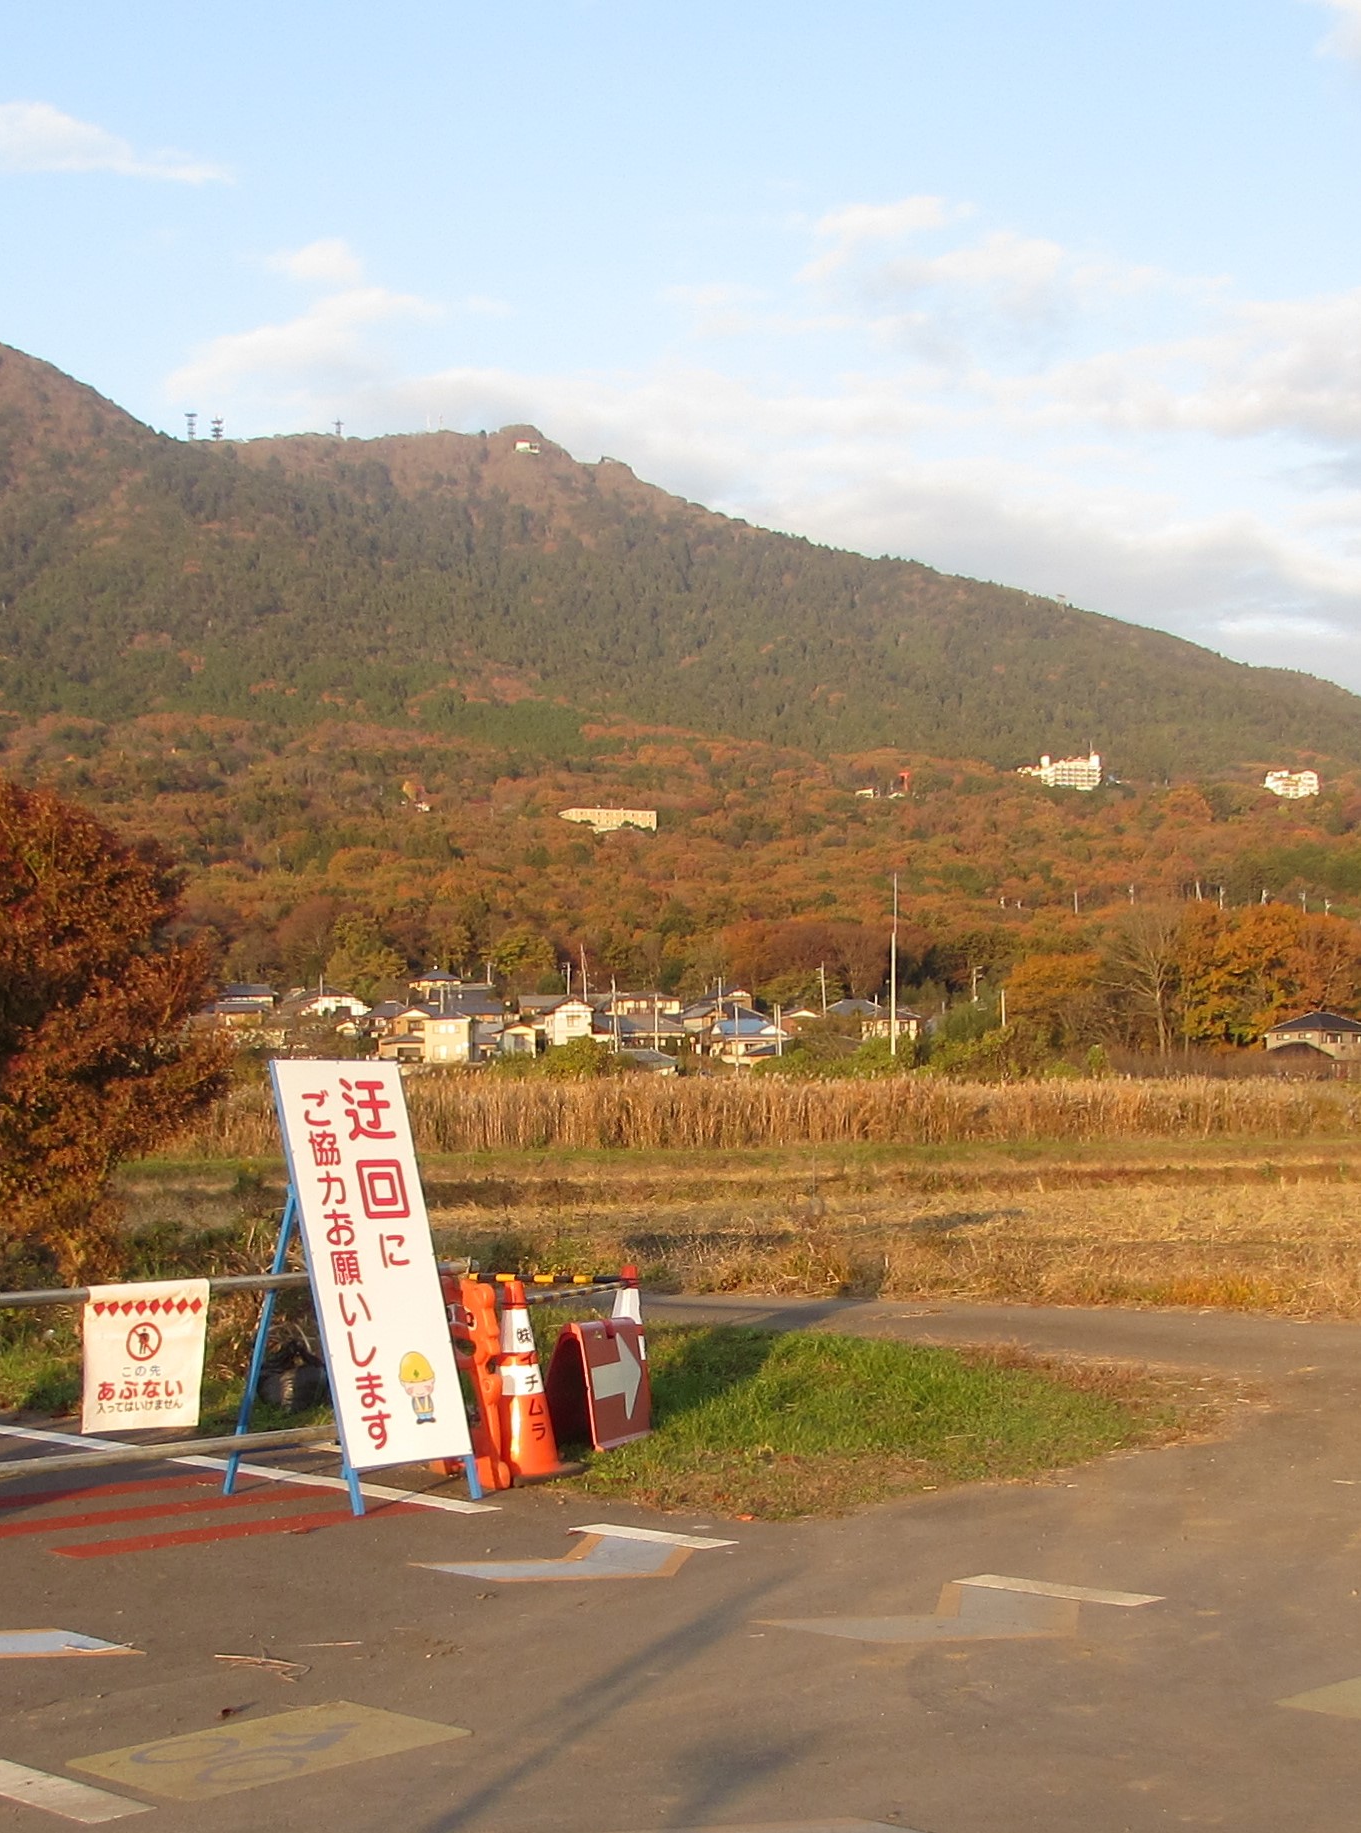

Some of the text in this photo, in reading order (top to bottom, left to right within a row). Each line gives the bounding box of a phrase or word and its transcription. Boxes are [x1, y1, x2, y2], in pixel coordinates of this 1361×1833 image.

[338, 1078, 411, 1268] 迂回に
[301, 1089, 392, 1450] ご協力お願いします
[122, 1365, 162, 1378] この先
[97, 1379, 184, 1401] あぶない
[96, 1399, 184, 1415] 入ってはいけません
